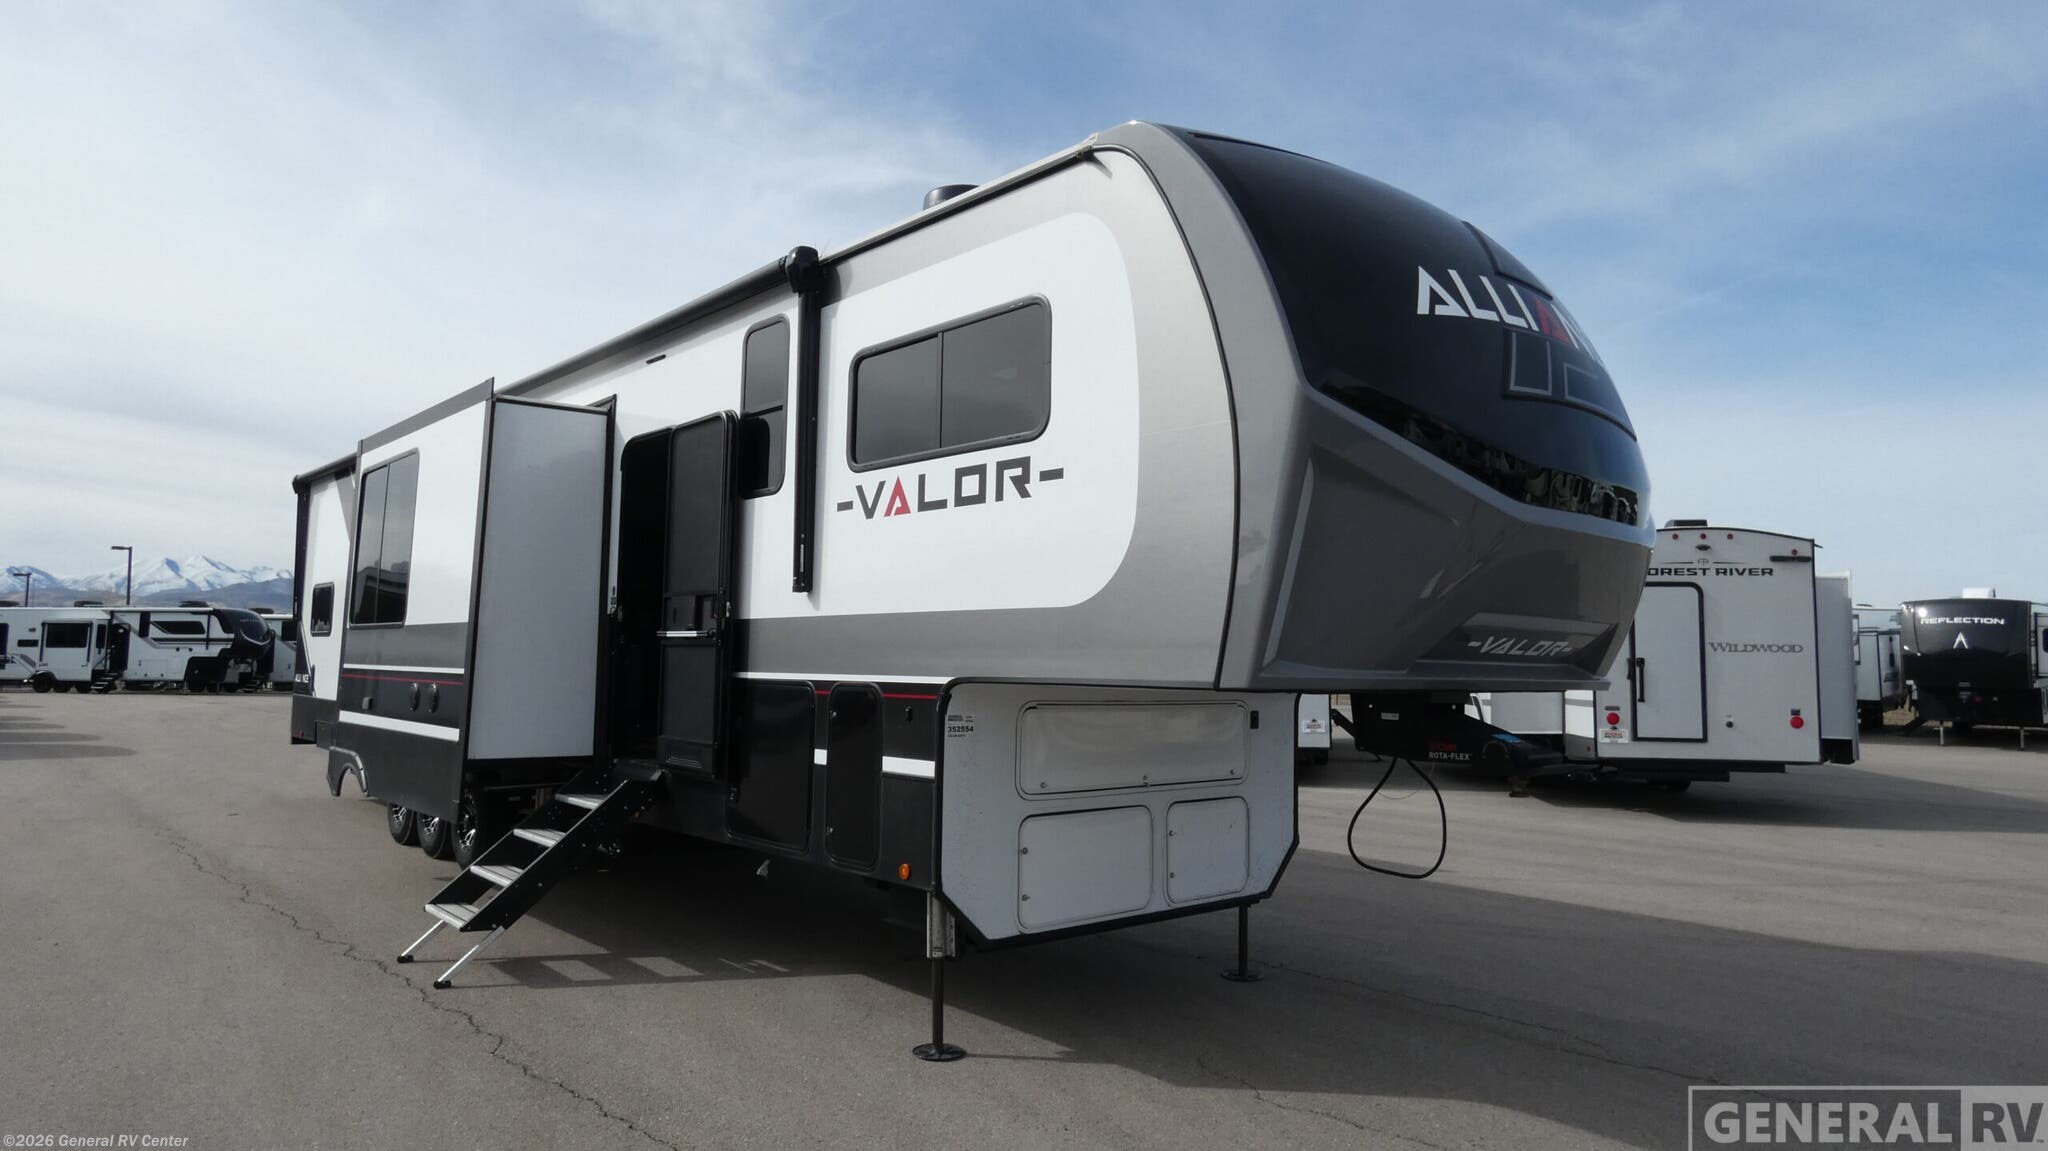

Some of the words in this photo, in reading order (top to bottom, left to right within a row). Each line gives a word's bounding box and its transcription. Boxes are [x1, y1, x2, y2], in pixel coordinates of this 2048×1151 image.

[1647, 567, 1710, 577] OREST
[1715, 567, 1774, 577] RIVER
[1920, 616, 2005, 625] REFLECTION
